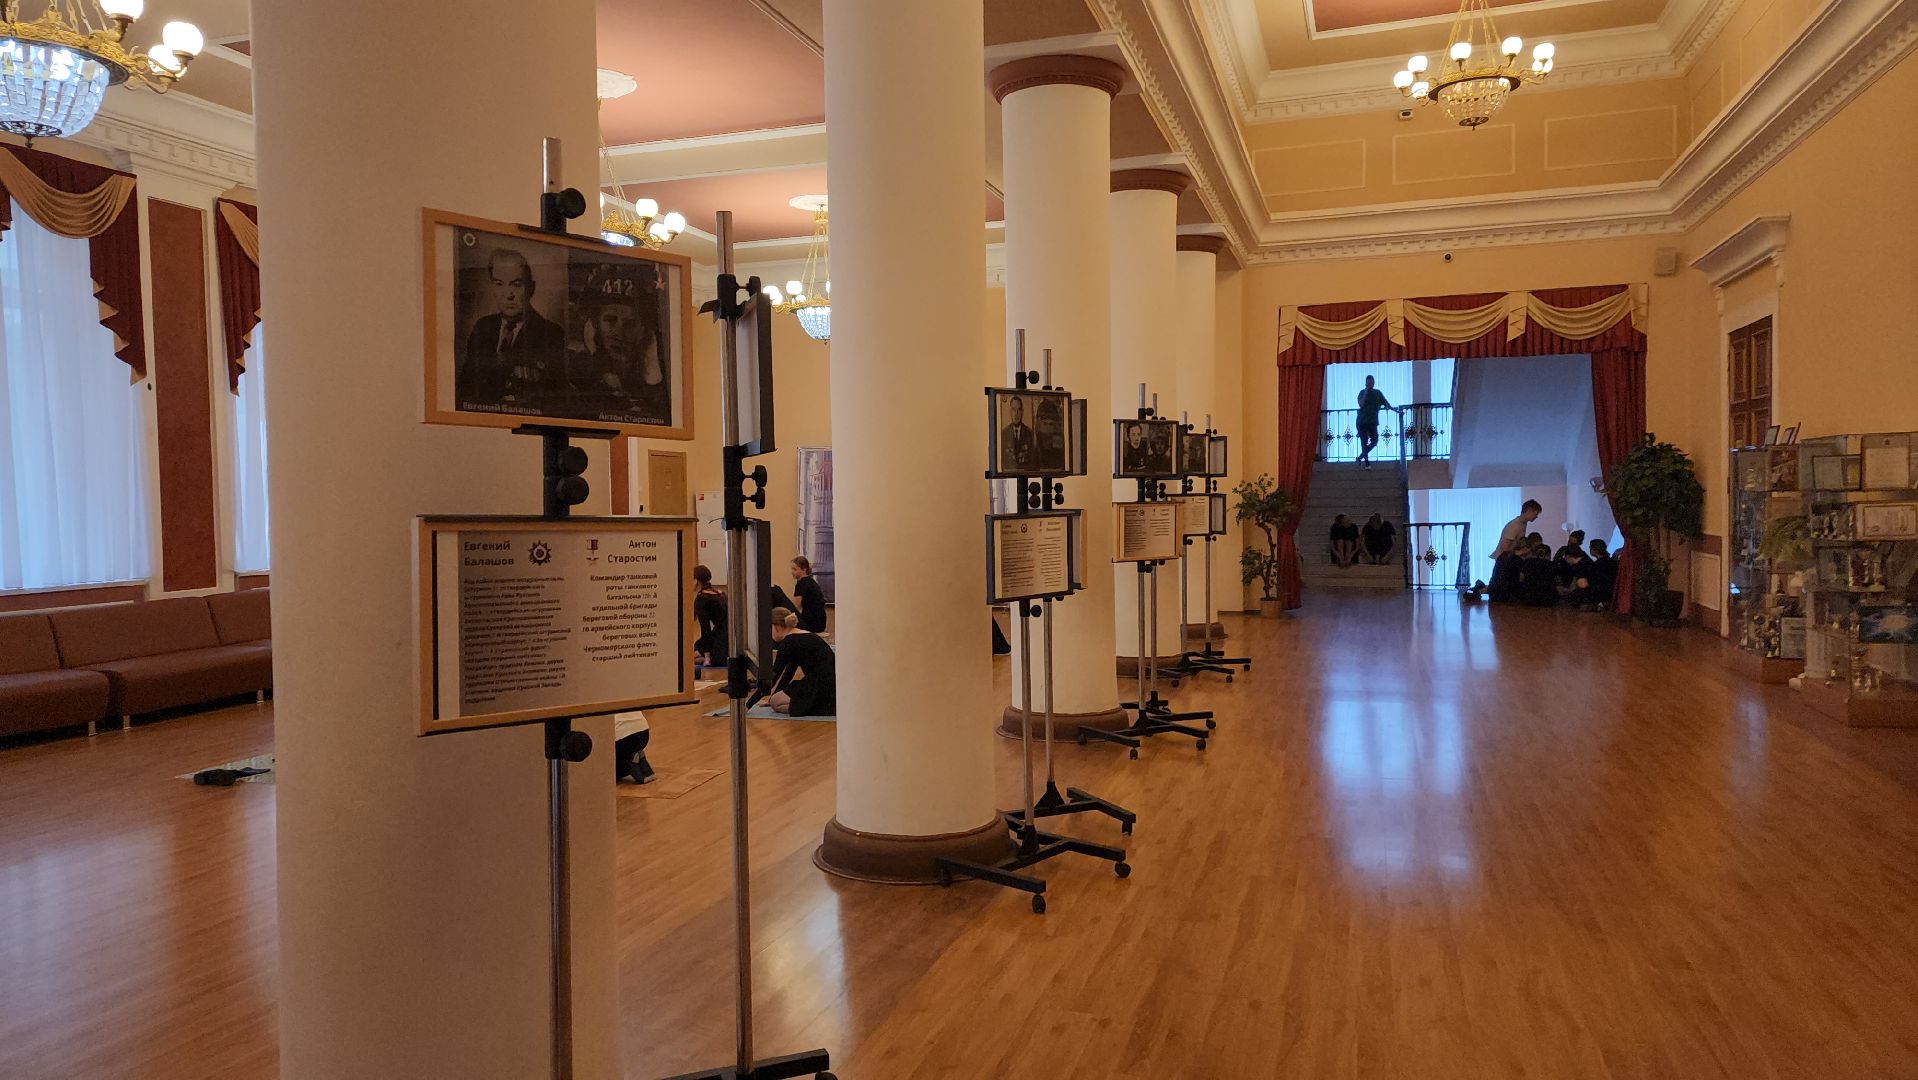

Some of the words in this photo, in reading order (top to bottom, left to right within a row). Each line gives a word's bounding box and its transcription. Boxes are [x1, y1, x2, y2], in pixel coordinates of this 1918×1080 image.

[462, 401, 501, 411] Евгений
[598, 411, 623, 421] Антон
[624, 414, 665, 424] Старостин
[464, 540, 511, 551] Евгений
[628, 539, 657, 548] Антон
[464, 557, 515, 567] Балашов
[607, 554, 657, 564] Старостин
[590, 574, 626, 583] Командир
[626, 573, 657, 581] танковой
[606, 593, 641, 601] батальона
[591, 603, 628, 612] отдельной
[629, 602, 658, 611] бригады
[582, 613, 618, 623] береговой
[618, 612, 648, 621] обороны
[590, 624, 631, 633] армейского
[631, 622, 657, 630] корпуса
[602, 633, 638, 642] береговых
[583, 643, 636, 653] Черноморского
[591, 653, 622, 662] старший
[623, 651, 658, 660] лейтенант
